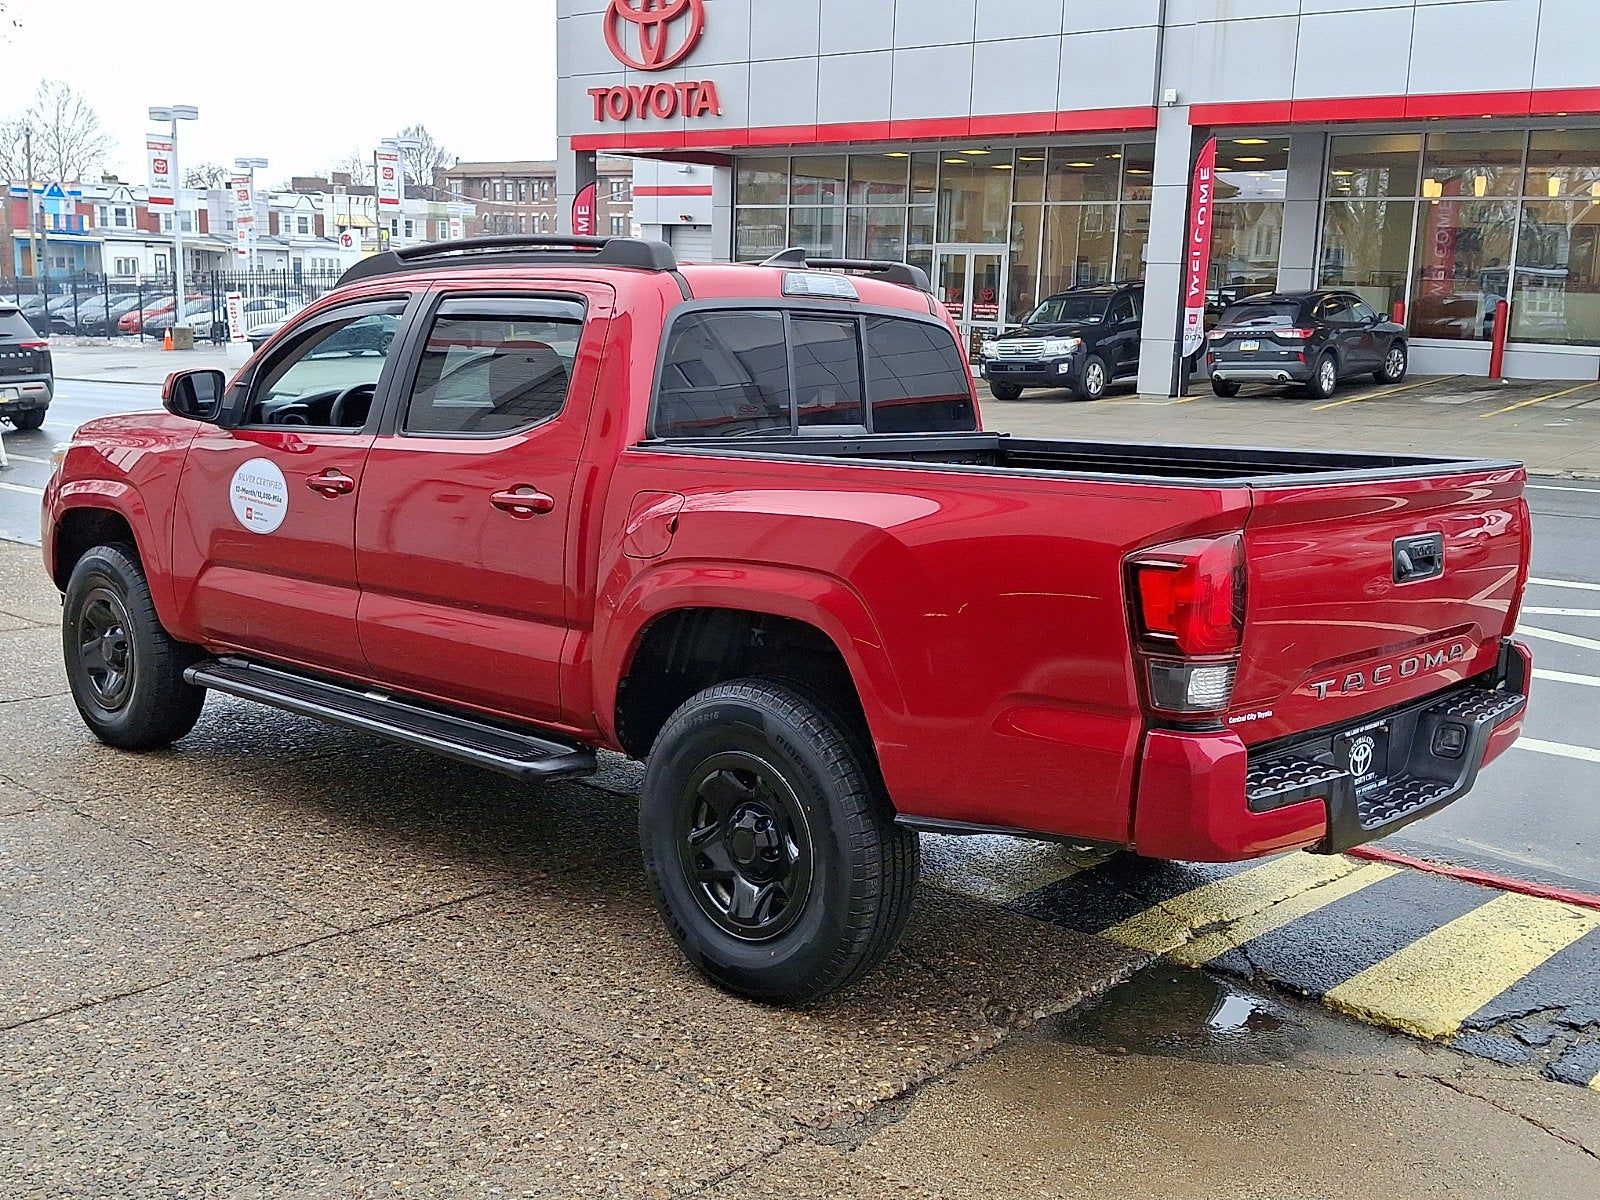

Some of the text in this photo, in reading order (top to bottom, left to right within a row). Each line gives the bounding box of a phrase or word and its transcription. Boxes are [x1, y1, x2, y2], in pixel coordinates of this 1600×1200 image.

[588, 80, 721, 121] TOYOTA
[238, 473, 283, 490] SILVER CERTIFIED
[1309, 643, 1465, 700] TACOMA
[1228, 709, 1273, 724] Central City Toyota
